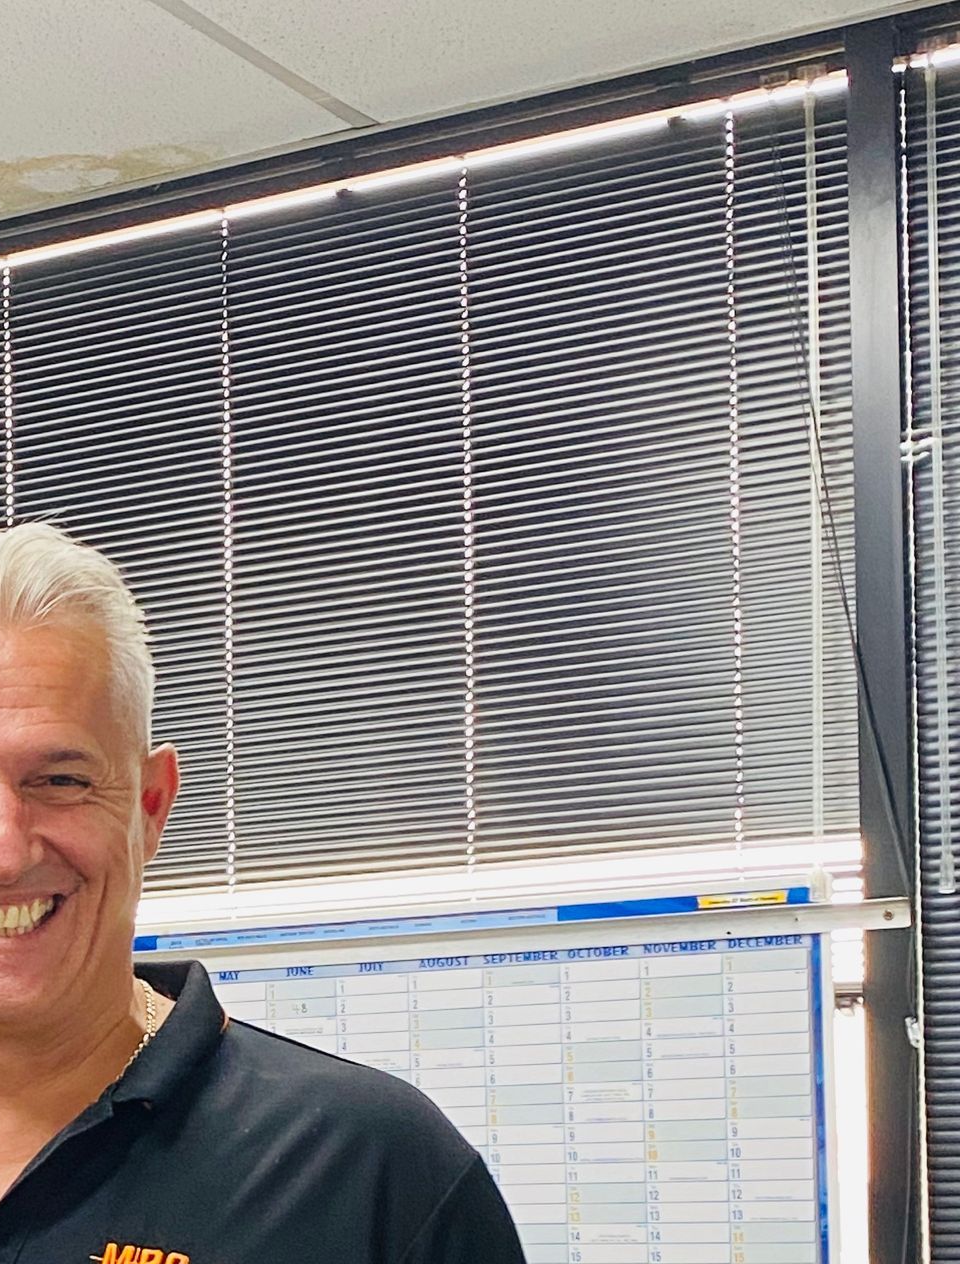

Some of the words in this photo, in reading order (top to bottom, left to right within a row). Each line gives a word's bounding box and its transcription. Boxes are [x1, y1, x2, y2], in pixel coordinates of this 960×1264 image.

[219, 971, 239, 981] MAY
[286, 966, 314, 977] JUNE
[358, 962, 384, 972] JULY
[419, 956, 470, 969] AUGUST
[483, 951, 558, 966] SEPTEMBER
[568, 948, 629, 960] OCTOBER
[643, 941, 716, 954] NOVEMBER
[728, 934, 803, 949] DECEMBER
[568, 1152, 577, 1161] 10
[730, 1148, 741, 1158] 10
[491, 1154, 500, 1163] 10
[569, 1172, 577, 1181] 11
[649, 1170, 658, 1180] 11
[731, 1169, 740, 1178] 11
[570, 1193, 580, 1202] 12
[649, 1191, 659, 1200] 12
[732, 1190, 742, 1199] 12
[650, 1211, 660, 1221] 13
[732, 1210, 743, 1220] 13
[570, 1232, 580, 1241] 14
[651, 1231, 660, 1241] 14
[571, 1252, 581, 1262] 15
[651, 1252, 661, 1262] 15
